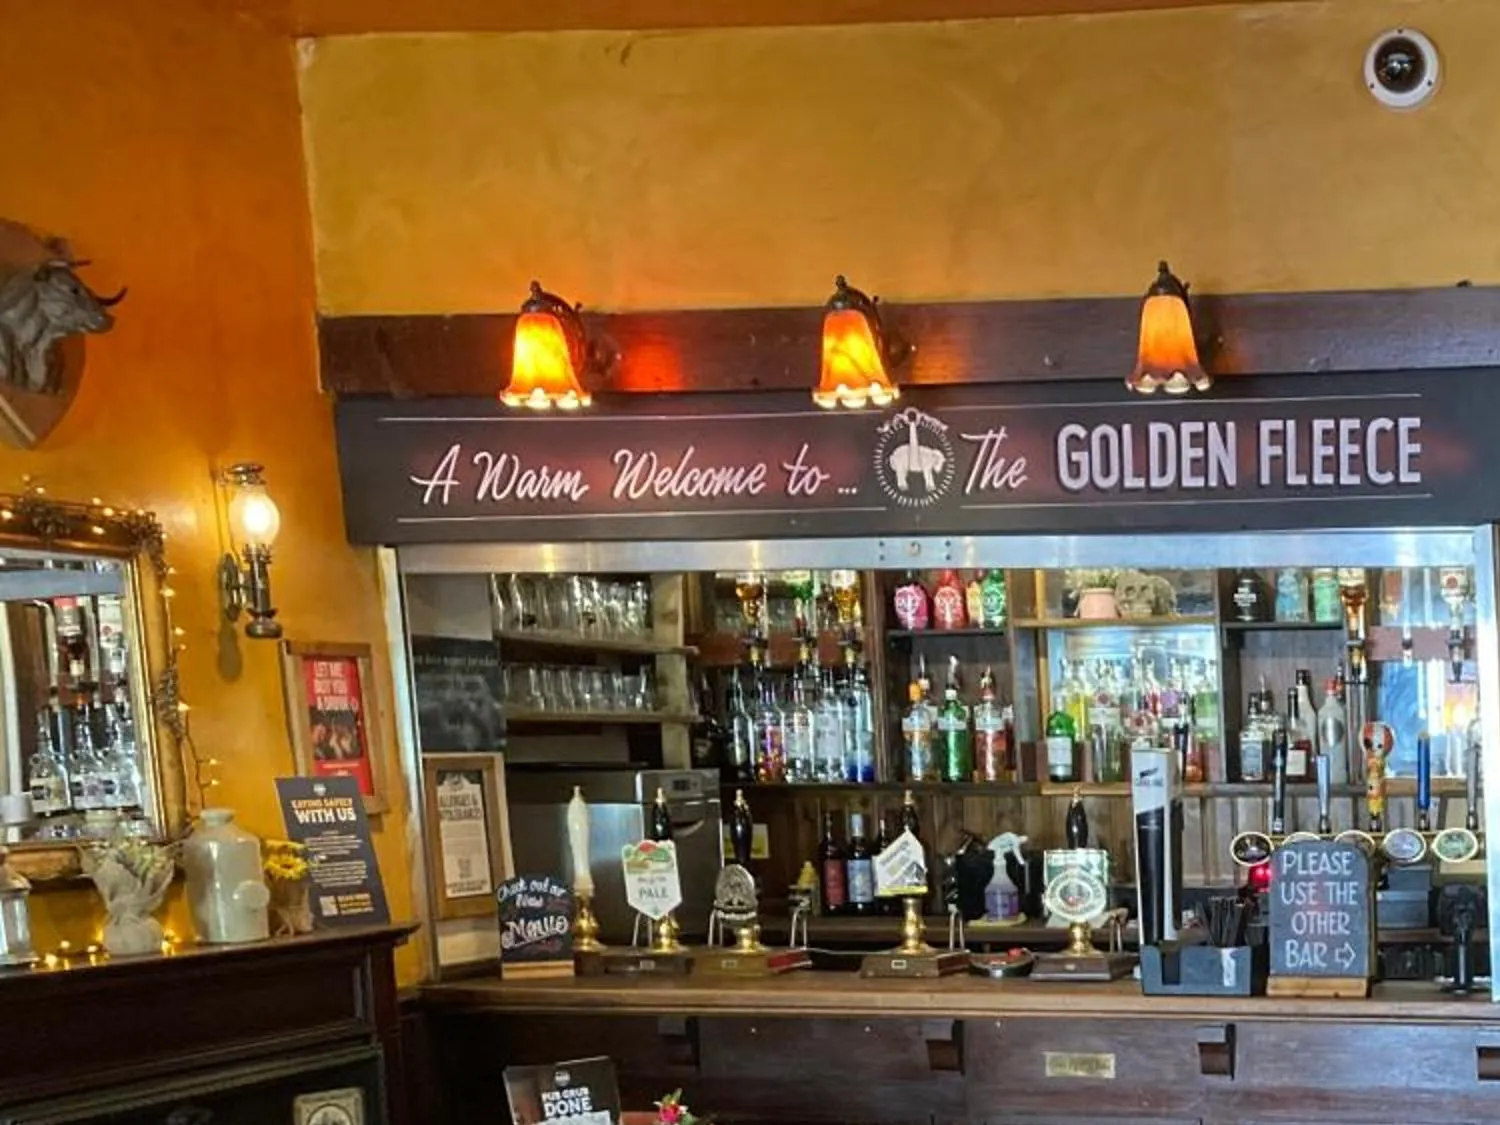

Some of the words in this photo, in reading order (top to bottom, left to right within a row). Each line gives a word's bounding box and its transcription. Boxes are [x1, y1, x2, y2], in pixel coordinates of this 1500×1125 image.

[410, 444, 461, 504] A
[473, 450, 589, 503] Warm
[611, 446, 768, 500] Welcome
[961, 424, 1029, 495] The
[1057, 422, 1237, 489] GOLDEN
[1259, 417, 1422, 486] FLEECE
[294, 809, 336, 825] WITH
[336, 807, 357, 821] US
[1282, 850, 1353, 875] PLEASE
[1281, 881, 1322, 905] USE
[1323, 880, 1359, 905] THE
[1291, 911, 1352, 935] OTHER
[1285, 939, 1328, 968] BAR
[541, 1091, 561, 1102] PUB
[562, 1087, 590, 1099] GRUB
[544, 1097, 593, 1117] DONE
